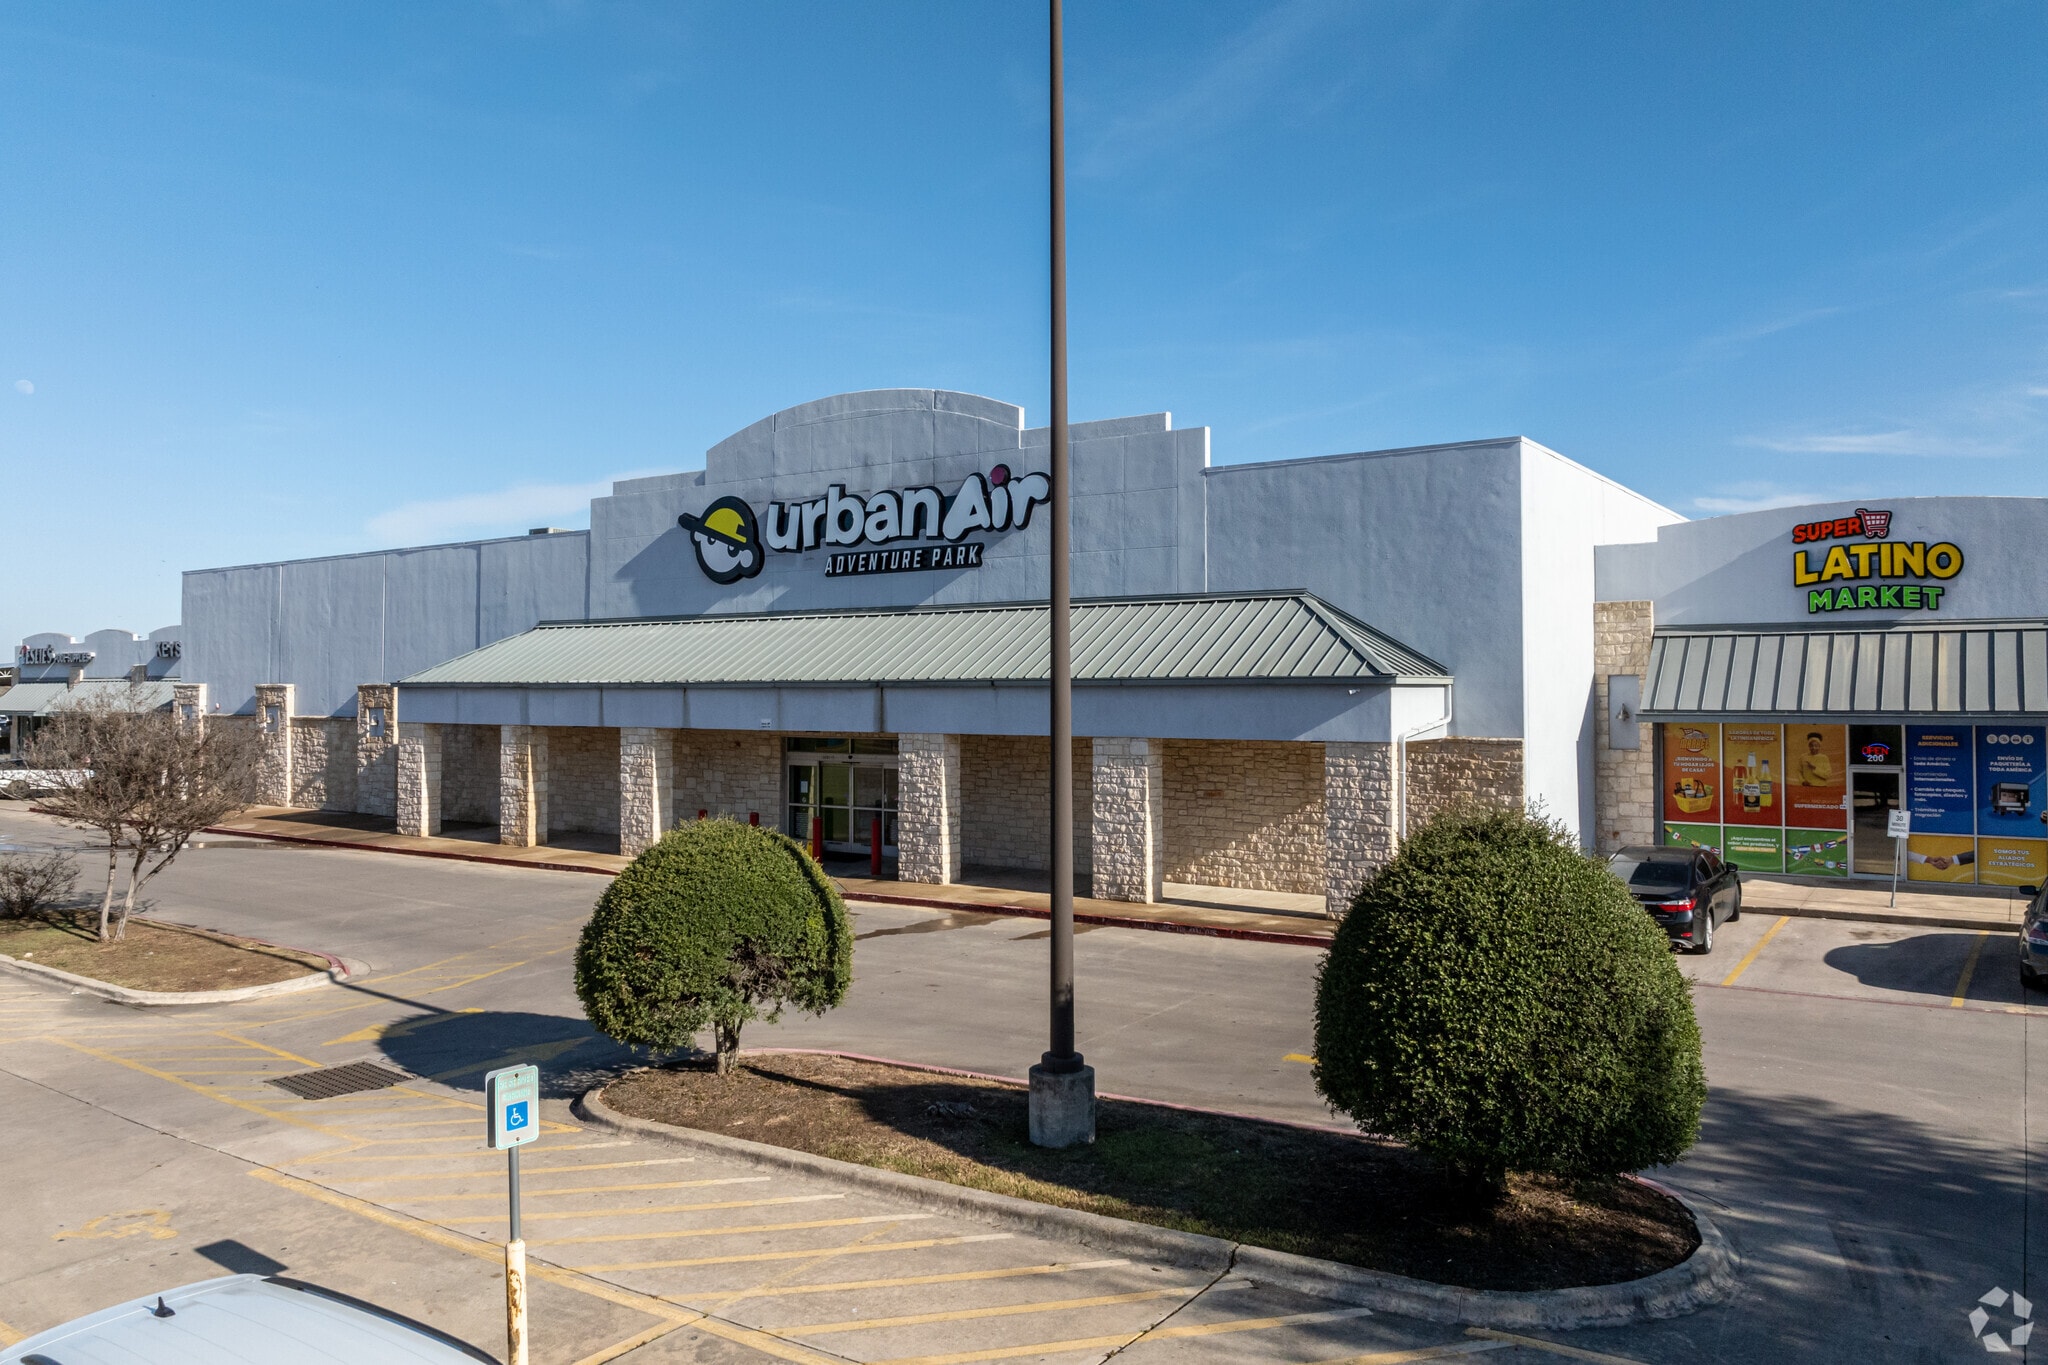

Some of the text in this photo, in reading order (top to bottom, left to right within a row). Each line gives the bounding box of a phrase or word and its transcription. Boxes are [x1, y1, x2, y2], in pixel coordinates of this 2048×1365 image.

[766, 463, 1051, 553] urban Air
[1792, 516, 1862, 544] SUPER
[824, 543, 980, 575] ADVENTURE PARK
[1794, 541, 1964, 587] LATINO
[1808, 585, 1945, 613] MARKET
[1862, 746, 1889, 756] OPEN
[1867, 754, 1884, 762] 200
[499, 1074, 534, 1089] RESERVED
